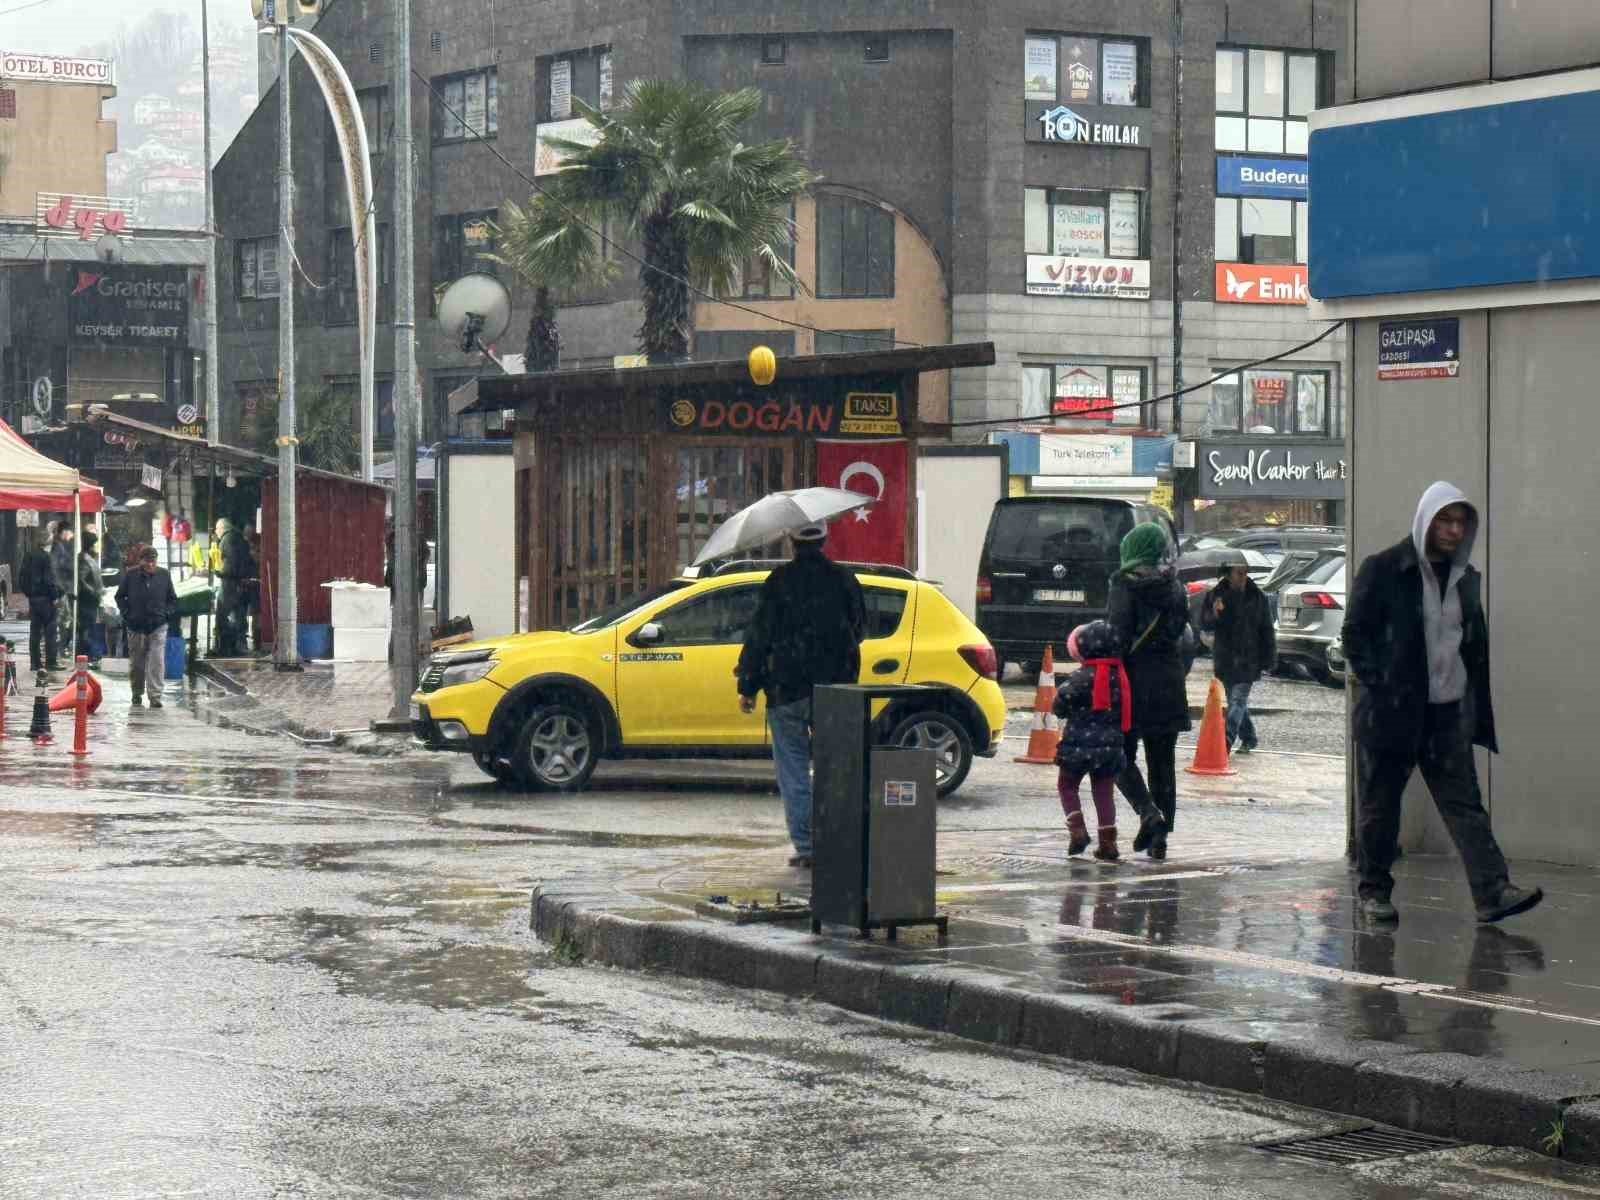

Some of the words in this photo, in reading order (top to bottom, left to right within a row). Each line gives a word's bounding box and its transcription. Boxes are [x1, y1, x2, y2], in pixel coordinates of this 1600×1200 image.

[5, 58, 48, 74] OTEL
[53, 61, 107, 78] BURCU
[1094, 123, 1139, 145] EMLAK
[1240, 167, 1308, 184] Buderu
[1071, 229, 1103, 241] BOSCH
[97, 276, 186, 297] Graniser
[1381, 327, 1436, 349] GAZİPAŞA
[702, 396, 833, 433] DOĞAN
[1257, 448, 1312, 480] Cankor
[1313, 458, 1338, 480] Hair
